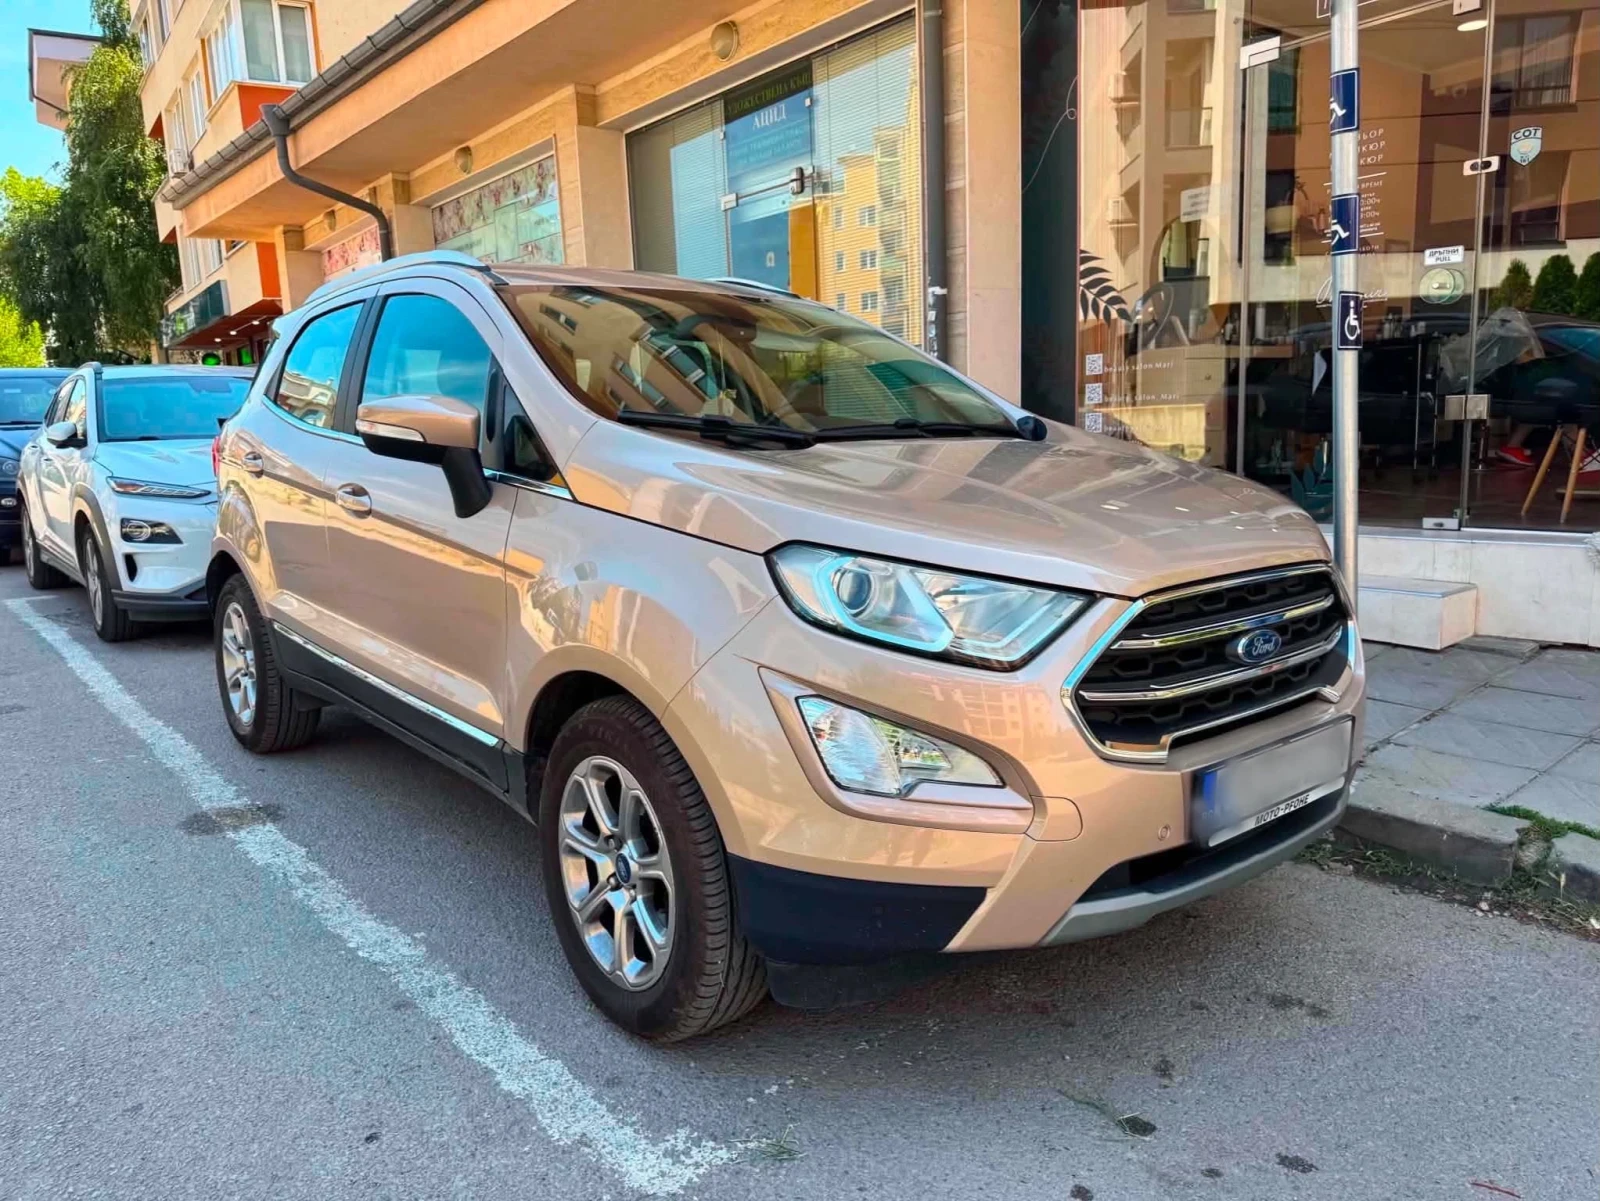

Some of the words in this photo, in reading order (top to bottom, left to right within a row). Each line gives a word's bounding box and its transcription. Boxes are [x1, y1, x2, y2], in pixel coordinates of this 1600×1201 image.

[1429, 248, 1459, 257] ДРЪПНИ
[1252, 635, 1277, 656] Ford
[1254, 793, 1310, 827] MOTO-PFOHE
